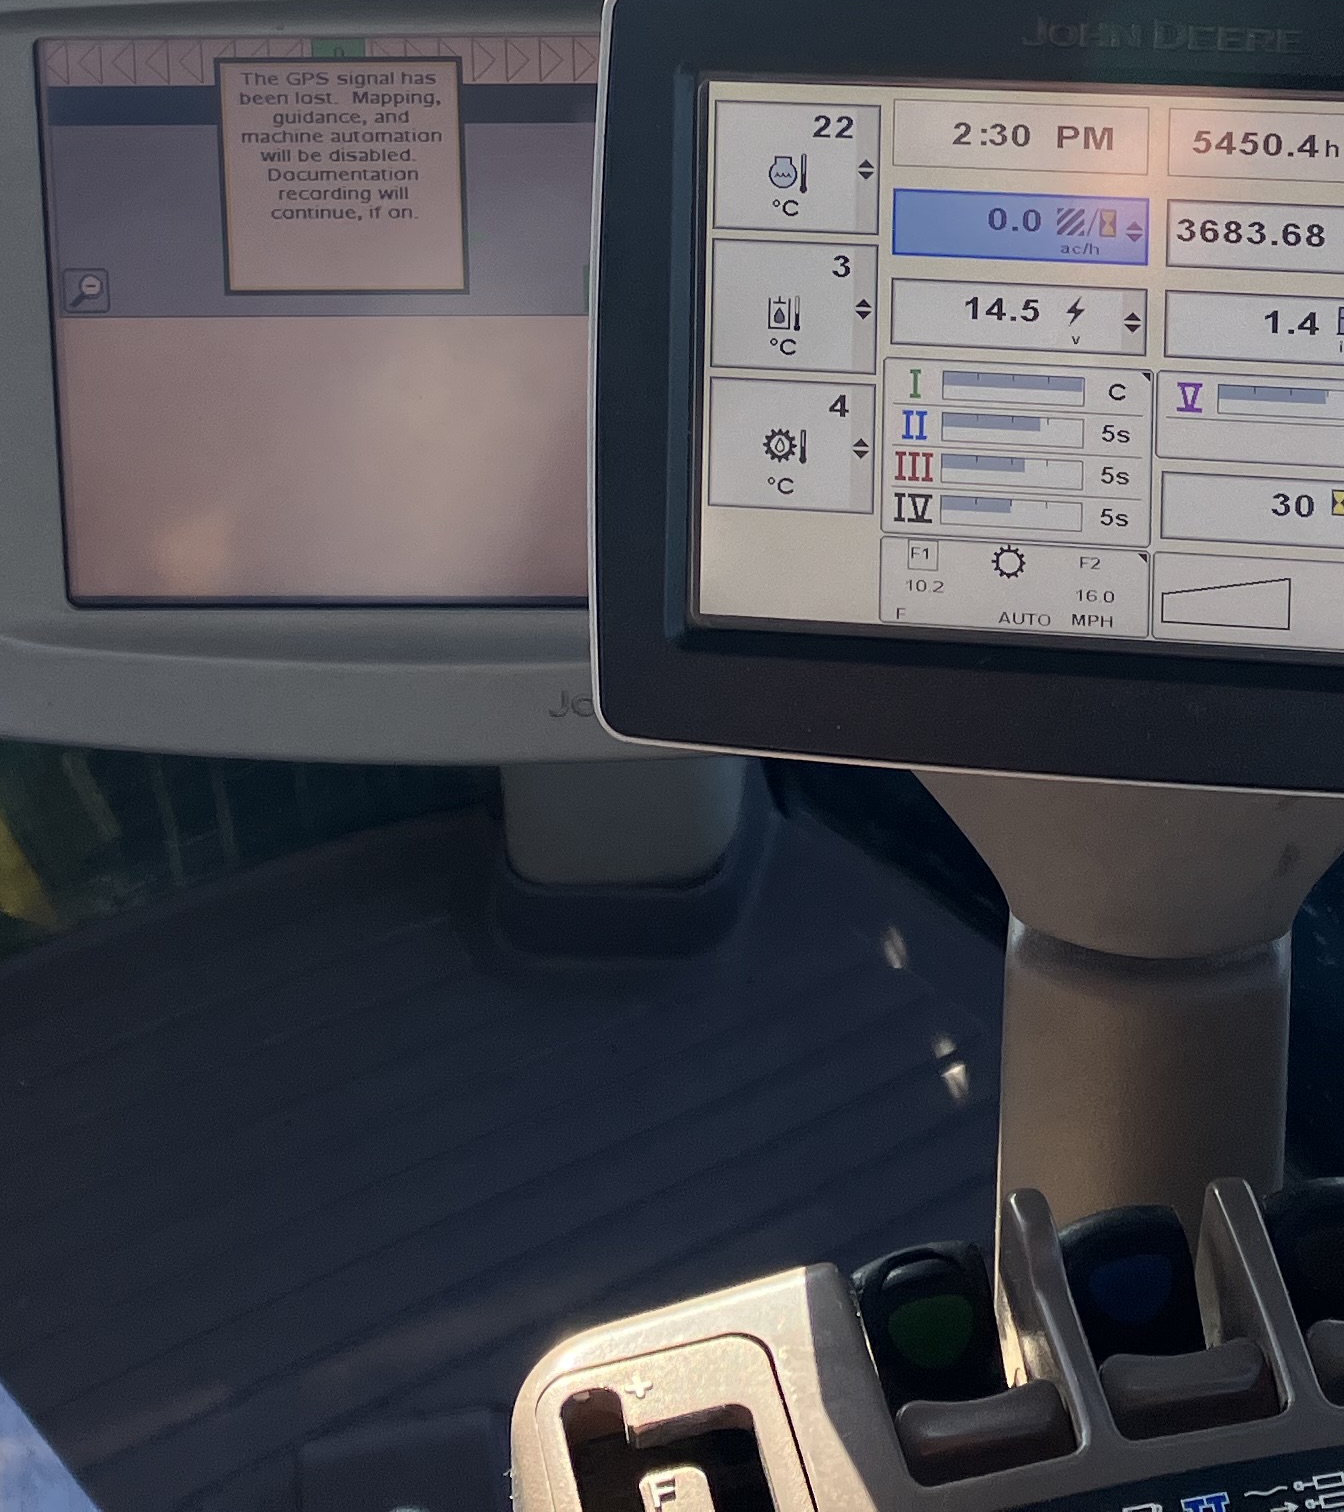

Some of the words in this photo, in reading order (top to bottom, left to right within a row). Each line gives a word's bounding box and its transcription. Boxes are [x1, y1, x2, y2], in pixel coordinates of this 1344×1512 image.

[1020, 16, 1142, 48] JOHN
[1152, 18, 1304, 54] DEERE
[240, 71, 279, 86] The
[286, 71, 330, 86] GPS
[336, 71, 394, 88] signal
[401, 71, 437, 85] has
[239, 91, 289, 105] been
[295, 91, 339, 105] lost.
[352, 91, 442, 107] Mapping,
[272, 110, 368, 127] guidance,
[374, 110, 410, 124] and
[812, 114, 854, 139] 22
[241, 129, 324, 144] machine
[330, 129, 443, 144] automation
[952, 121, 1032, 147] 2:30
[1057, 125, 1115, 151] PM
[1192, 129, 1320, 159] 5450.4
[1325, 139, 1340, 158] h
[260, 148, 291, 162] will
[298, 148, 323, 162] be
[329, 148, 417, 163] disabled.
[267, 168, 419, 182] Documentation
[278, 187, 372, 204] recording
[378, 186, 409, 200] will
[270, 205, 363, 221] continue,
[369, 205, 383, 219] if
[388, 206, 419, 220] on.
[772, 198, 800, 217] °C
[987, 207, 1043, 232] 0.0
[1176, 218, 1326, 248] 3683.68
[1060, 242, 1101, 256] ac/h
[832, 255, 851, 278] 3
[964, 296, 1041, 323] 14.5
[1263, 309, 1320, 336] 1.4
[769, 337, 797, 356] °C
[1108, 382, 1127, 402] C
[1176, 381, 1203, 414] V
[828, 394, 850, 418] 4
[901, 409, 929, 441] II
[1101, 424, 1131, 444] 5s
[894, 450, 935, 483] III
[1100, 466, 1131, 486] 5s
[767, 475, 795, 495] °C
[893, 491, 934, 524] IV
[1271, 492, 1315, 519] 30
[1099, 507, 1129, 527] 5s
[910, 546, 930, 560] F1
[1079, 556, 1101, 570] F2
[906, 579, 945, 594] 10.2
[1075, 589, 1115, 604] 16.0
[896, 607, 906, 620] F
[997, 611, 1052, 627] AUTO
[1071, 613, 1114, 628] MPH
